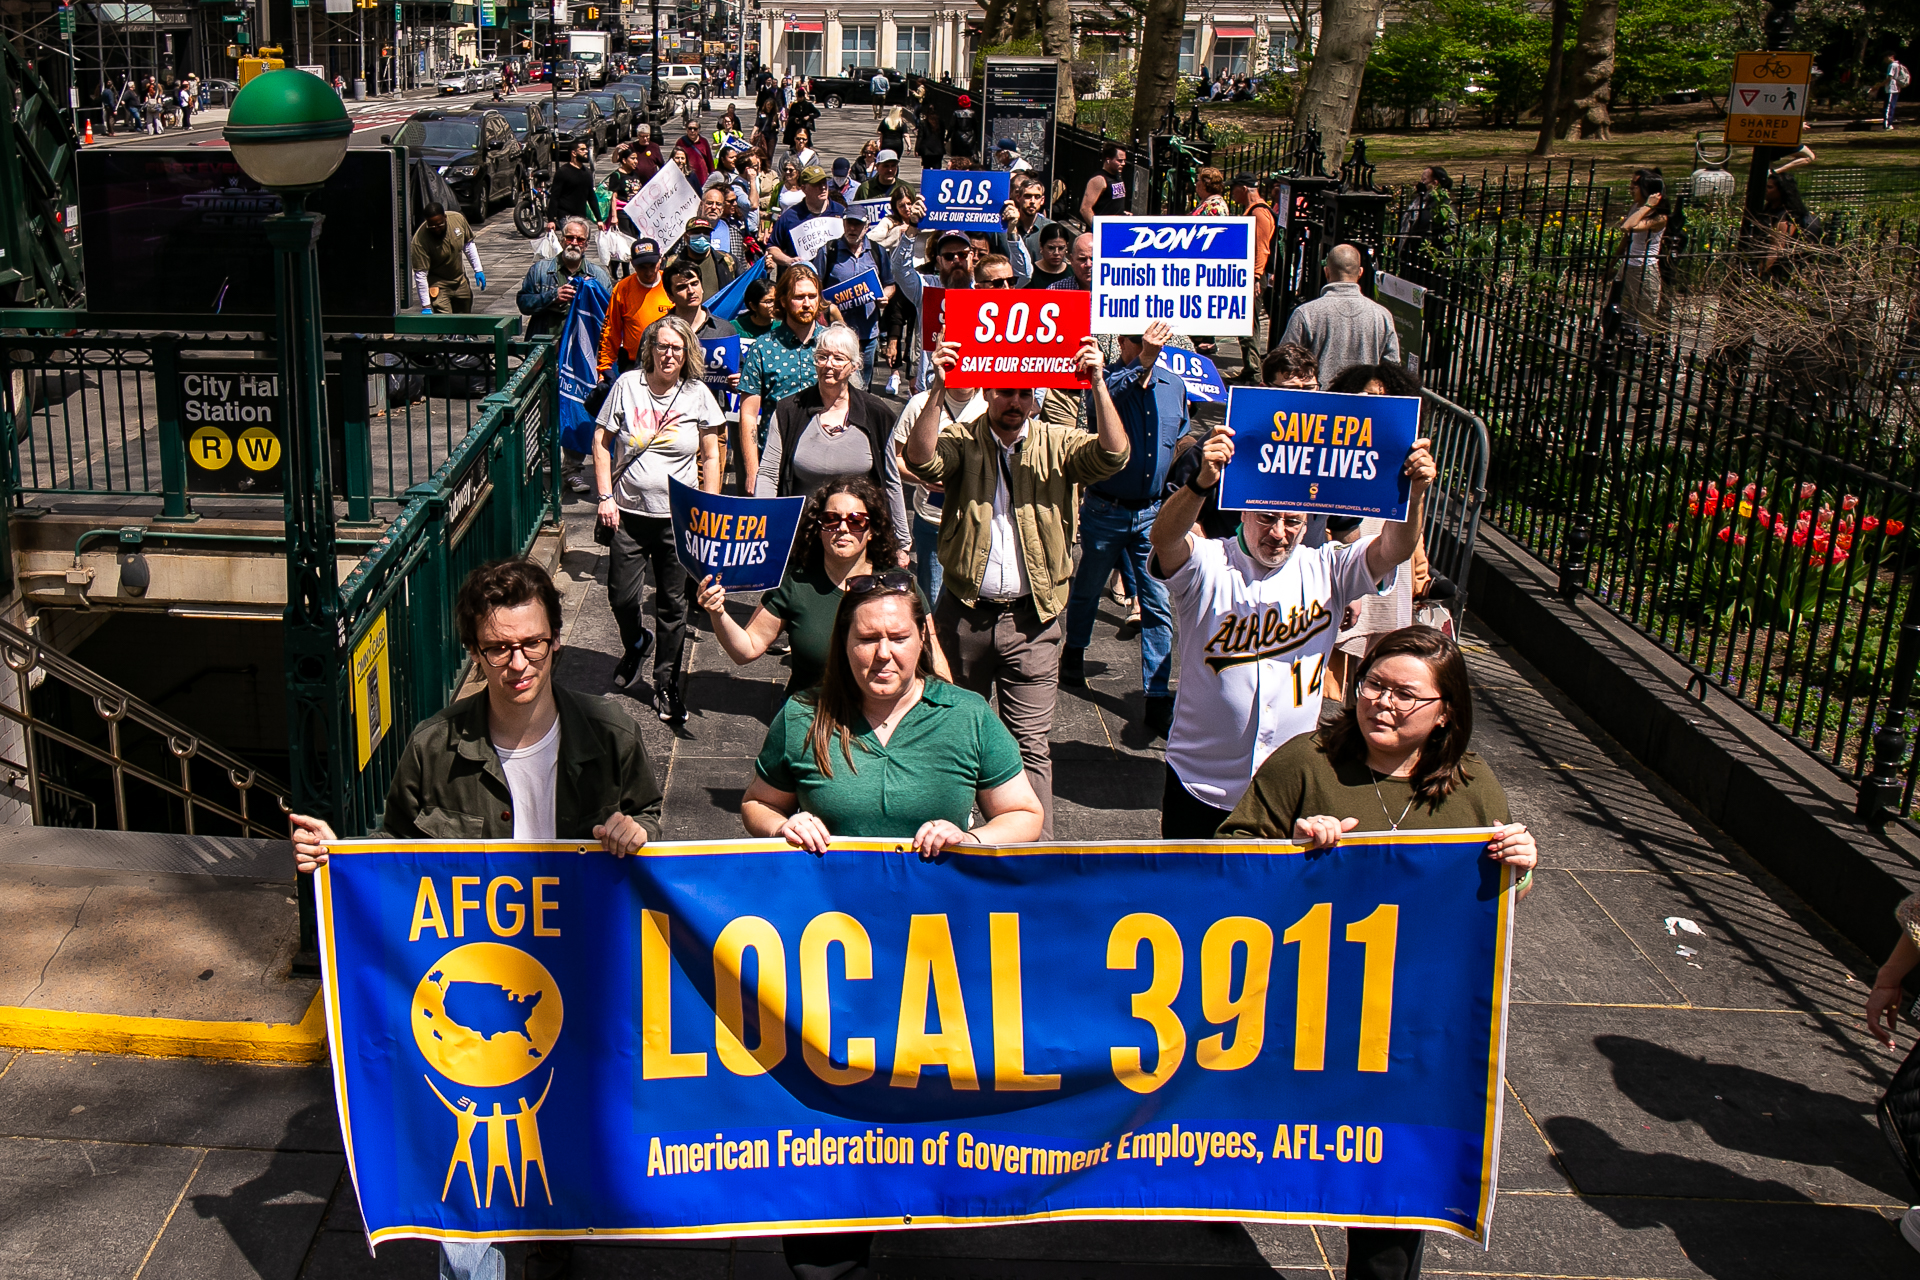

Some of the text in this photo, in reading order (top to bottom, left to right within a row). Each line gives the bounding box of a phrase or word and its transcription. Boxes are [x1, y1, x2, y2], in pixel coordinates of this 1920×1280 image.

[1764, 94, 1777, 103] TO
[1740, 118, 1789, 128] SHARED
[1747, 129, 1778, 139] ZONE
[938, 178, 993, 205] S.O.S.
[929, 211, 1000, 223] SAVE OUR SERVICES
[797, 229, 834, 247] FEDERAL
[1120, 224, 1228, 257] DON'T
[1100, 263, 1247, 287] Punish the Public
[834, 281, 870, 304] SAVE EPA
[840, 291, 876, 311] AVE LIVES
[1100, 294, 1246, 319] Fund the US EPA!
[975, 302, 1064, 343] S.O.S.
[961, 356, 1077, 373] SAVE OUR SERVICES
[184, 375, 279, 401] City Hal
[185, 400, 272, 422] Station
[1271, 410, 1372, 448] SAVE EPA
[202, 436, 273, 462] R W
[1257, 443, 1380, 481] SAVE LIVES
[690, 507, 767, 540] SAVE EPA
[685, 529, 769, 567] SAVE LIVES
[371, 627, 386, 656] CARD
[1291, 653, 1326, 708] 14
[409, 876, 561, 941] AFGE
[642, 903, 1399, 1094] LOCAL 3911
[647, 1124, 1383, 1177] American Federation of Government Employees, AFL-CIO
